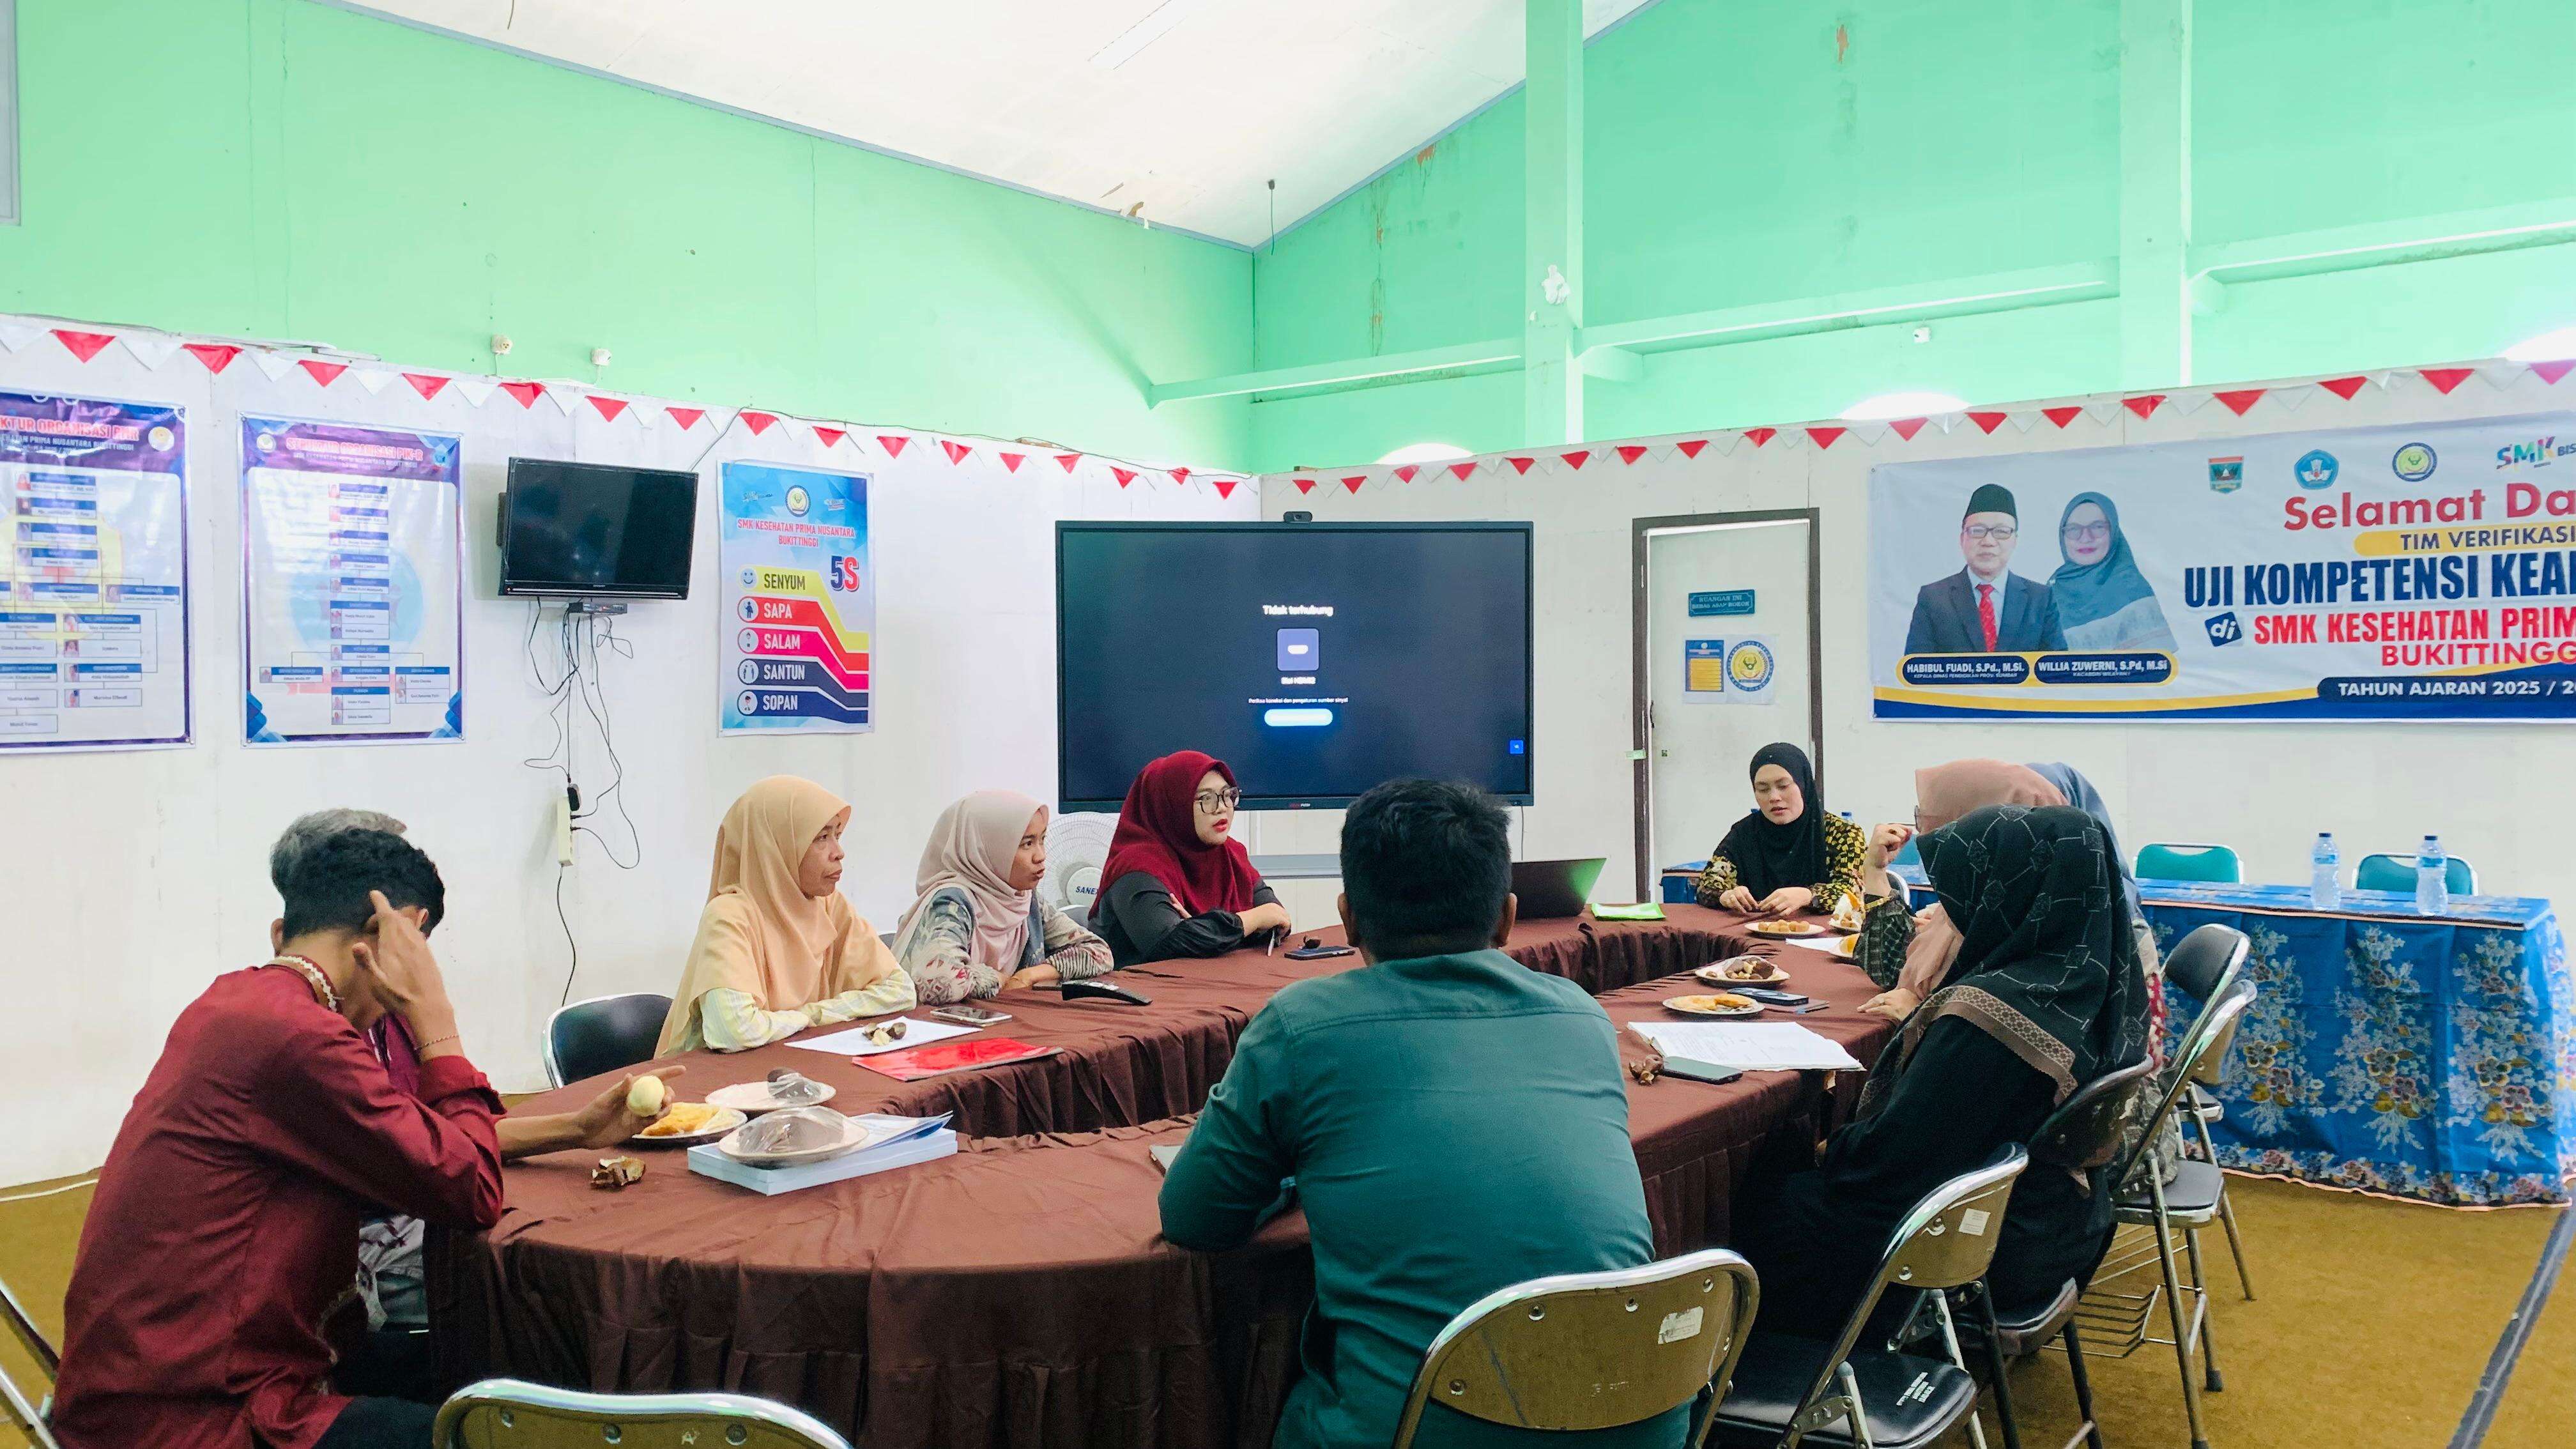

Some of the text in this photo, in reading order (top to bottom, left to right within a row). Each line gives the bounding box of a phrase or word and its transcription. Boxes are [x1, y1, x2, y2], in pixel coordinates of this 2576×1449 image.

[2284, 489, 2485, 530] Selamat
[737, 519, 855, 537] SMK KESEHATAN PRIMA NUSANTARA
[778, 535, 818, 548] BUKITTINGGI
[2400, 525, 2575, 551] TIM VERIFIKASI
[831, 555, 859, 592] 5S
[2184, 565, 2234, 608] UJI
[2244, 555, 2479, 606] KOMPETENSI
[764, 574, 805, 590] SENYUM
[763, 603, 792, 619] SAPA
[2211, 618, 2236, 640] di
[2255, 614, 2318, 645] SMK
[2328, 609, 2488, 643] KESEHATAN
[764, 633, 801, 650] SALAM
[763, 664, 805, 680] SANTUN
[1907, 663, 1944, 673] HABIBUL
[1946, 663, 1974, 673] FUADI,
[2038, 662, 2069, 671] WILLIA
[2338, 680, 2576, 696] TAHUN AJARAN 2025 / 2
[763, 694, 798, 710] SOPAN
